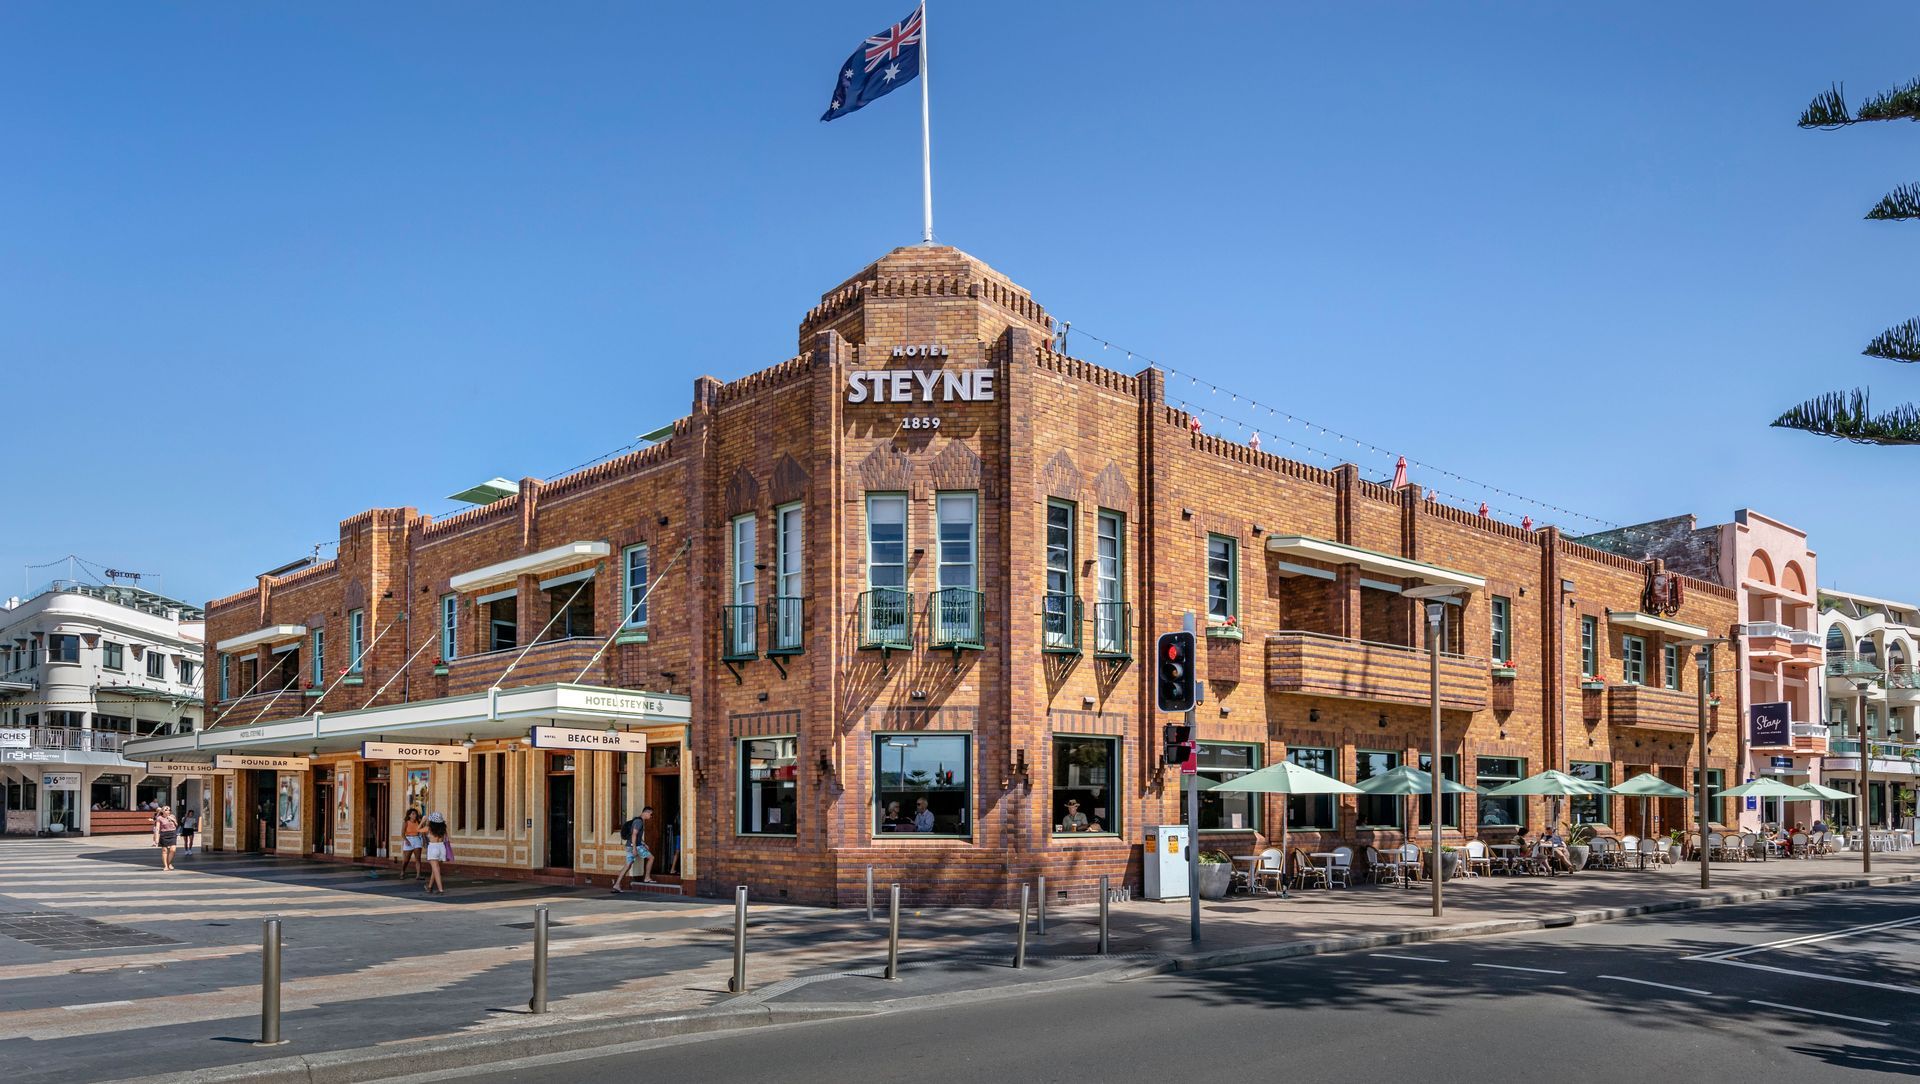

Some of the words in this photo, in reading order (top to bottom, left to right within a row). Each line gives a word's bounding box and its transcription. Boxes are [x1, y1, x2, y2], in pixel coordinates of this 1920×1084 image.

[892, 345, 949, 357] HOTEL
[848, 369, 994, 403] STEYNE
[902, 417, 941, 430] 1859
[104, 569, 141, 580] Corona
[585, 696, 617, 707] HOTEL
[620, 700, 655, 711] STEYNE
[1756, 715, 1782, 731] Stay
[567, 733, 599, 744] BEACH
[602, 736, 620, 745] BAR
[398, 747, 440, 756] ROOFTOP
[241, 759, 270, 767] ROUND
